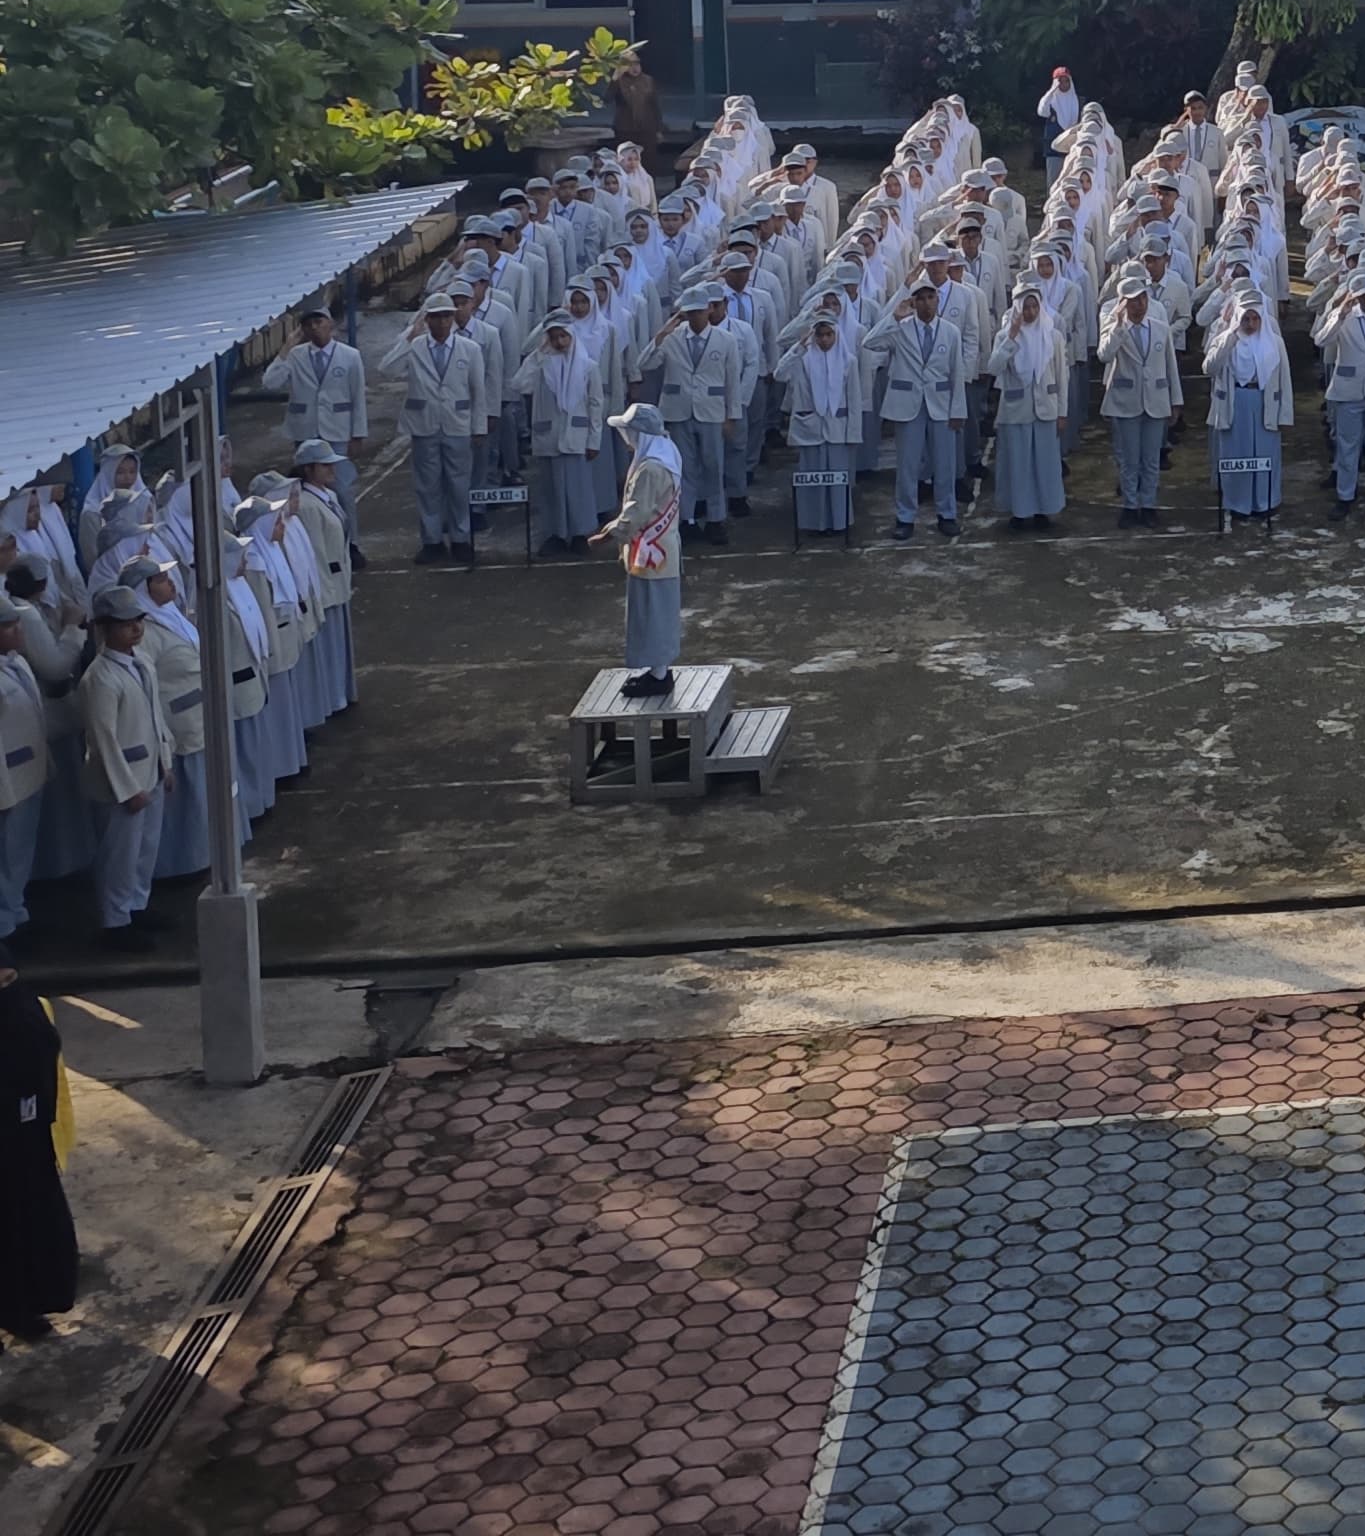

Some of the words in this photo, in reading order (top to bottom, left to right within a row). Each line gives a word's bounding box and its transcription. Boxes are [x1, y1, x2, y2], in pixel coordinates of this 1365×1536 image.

[1221, 460, 1244, 471] KELAS
[1246, 460, 1257, 470] XII
[795, 474, 819, 484] KELAS
[822, 473, 834, 483] XII
[472, 491, 497, 501] KELAS
[500, 490, 512, 500] XII
